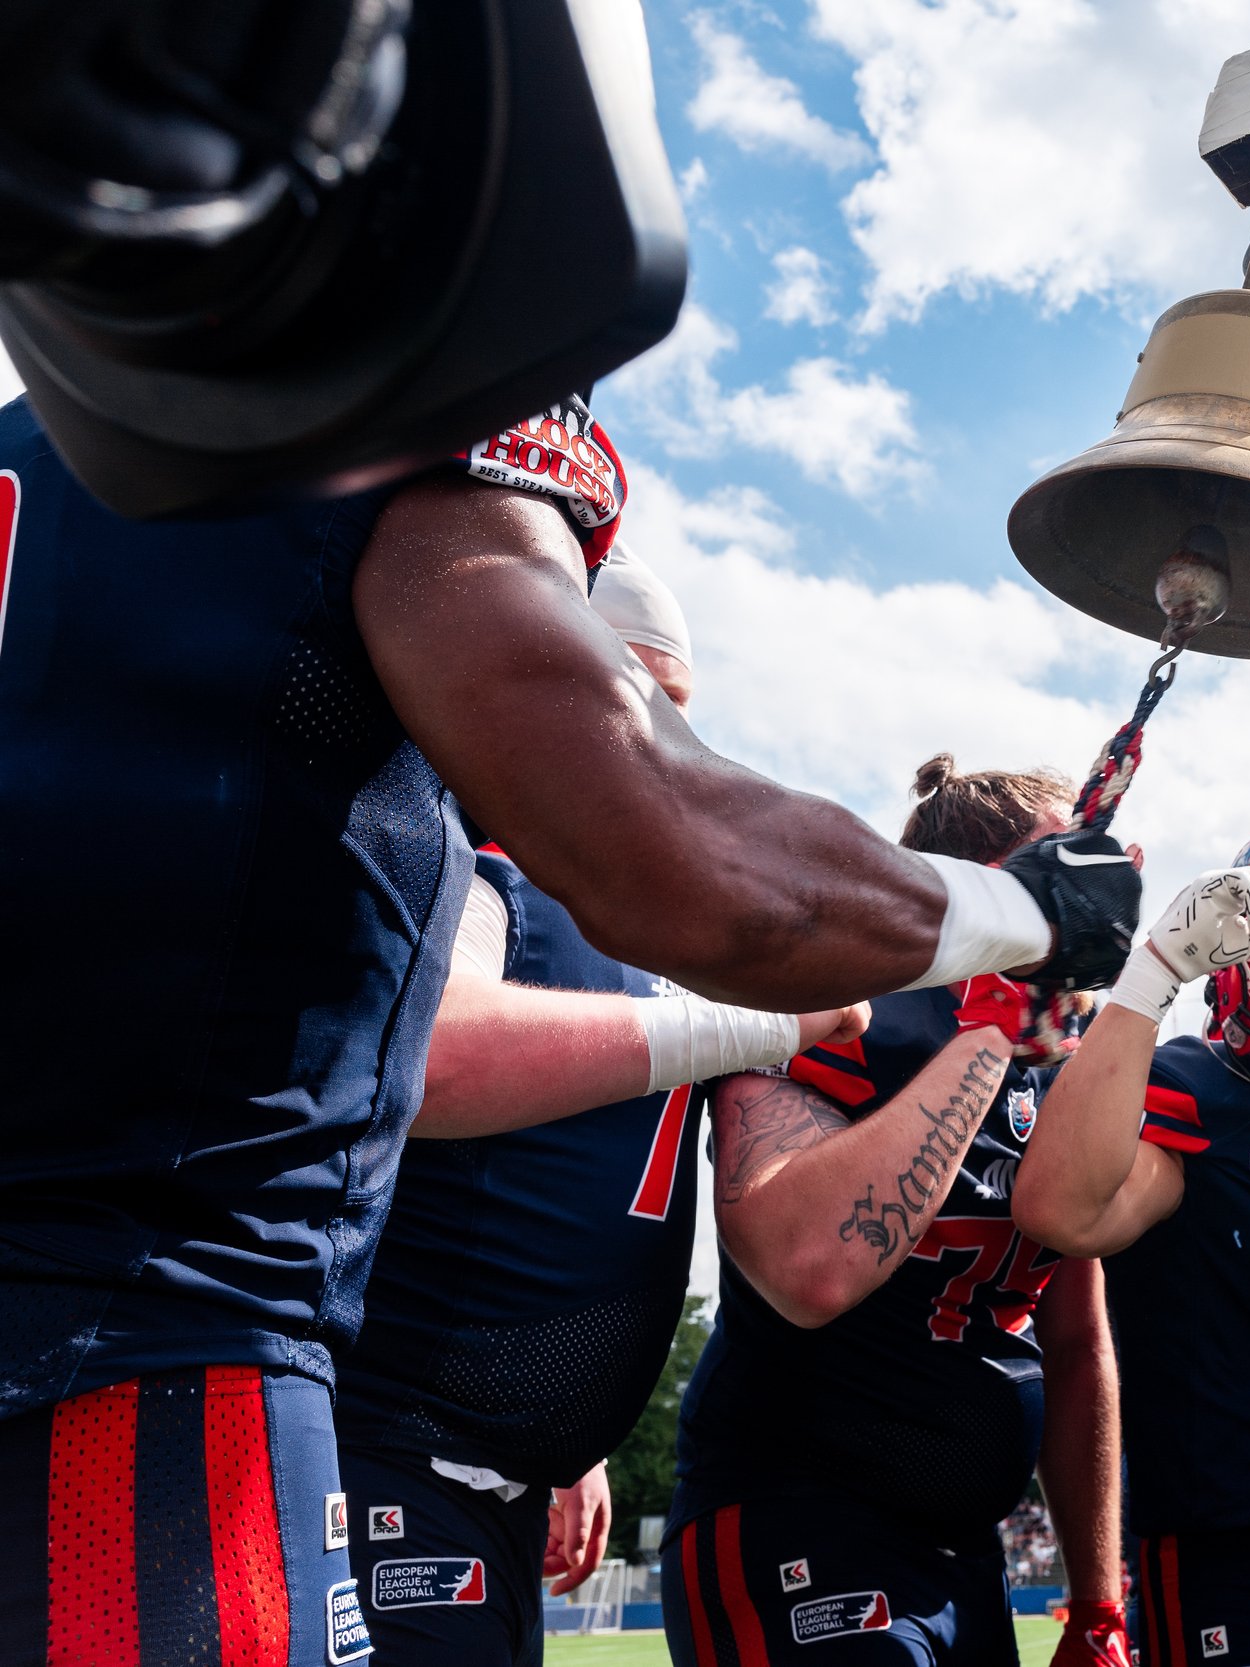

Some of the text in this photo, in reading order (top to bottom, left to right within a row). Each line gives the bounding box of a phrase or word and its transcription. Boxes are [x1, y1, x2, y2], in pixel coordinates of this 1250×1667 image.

[514, 418, 611, 483] LOCK
[478, 466, 508, 482] BEST
[481, 432, 615, 521] HOUSE
[746, 1067, 767, 1076] INCE
[373, 1525, 400, 1535] PRO
[379, 1566, 438, 1579] EUROPEAN
[379, 1577, 421, 1590] LEAGUE
[379, 1586, 435, 1601] FOOTBALL
[797, 1602, 844, 1619] EUROPEAN
[798, 1612, 832, 1627] LEAGUE
[799, 1620, 844, 1636] FOOTBALL
